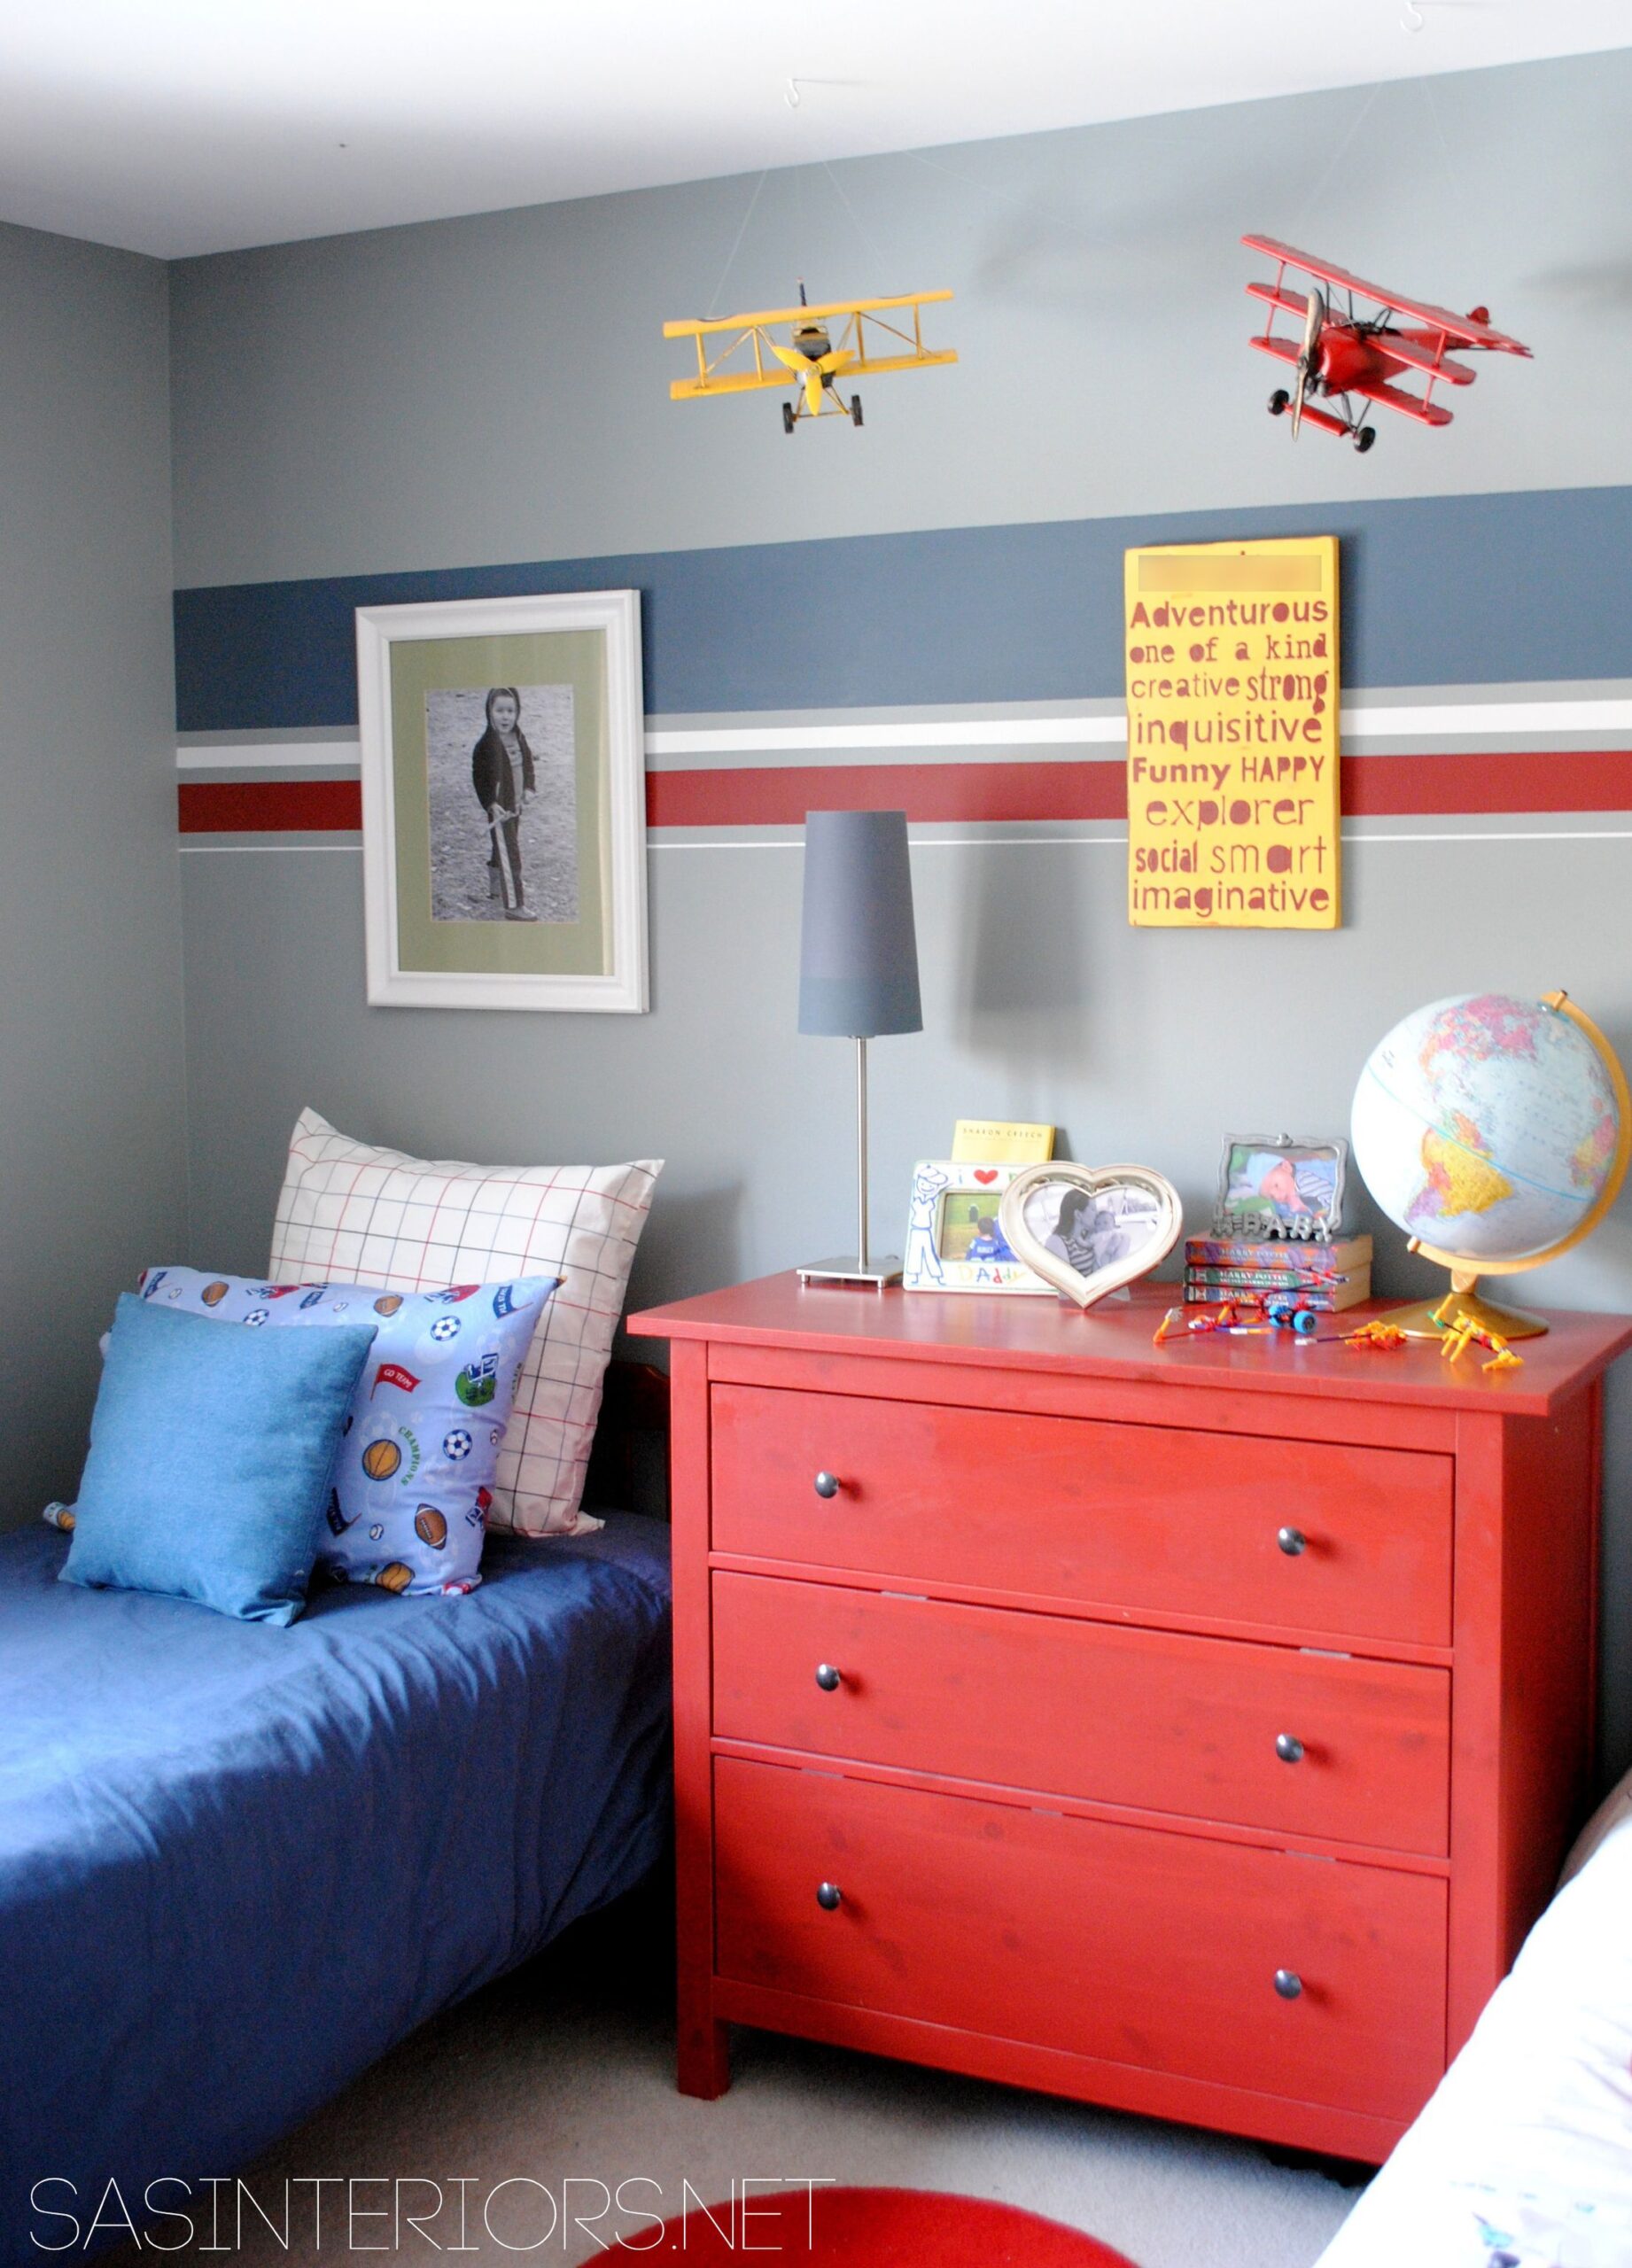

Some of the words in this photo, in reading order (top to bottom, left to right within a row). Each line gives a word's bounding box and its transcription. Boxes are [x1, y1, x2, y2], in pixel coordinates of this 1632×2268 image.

[1130, 599, 1329, 629] Adventurous
[1129, 643, 1175, 664] one
[1188, 636, 1219, 663] of
[1234, 641, 1250, 661] a
[1265, 632, 1328, 660] kind
[1131, 672, 1240, 698] creative
[1246, 665, 1330, 716] strong
[1137, 710, 1323, 752] inquisitive
[1132, 756, 1232, 791] Funny
[1241, 755, 1325, 783] HAPPY
[1146, 795, 1315, 832] explorer
[1135, 839, 1198, 874] social
[1209, 835, 1327, 874] smart
[1132, 879, 1330, 919] imaginative
[398, 1426, 421, 1487] CHAMPIONS
